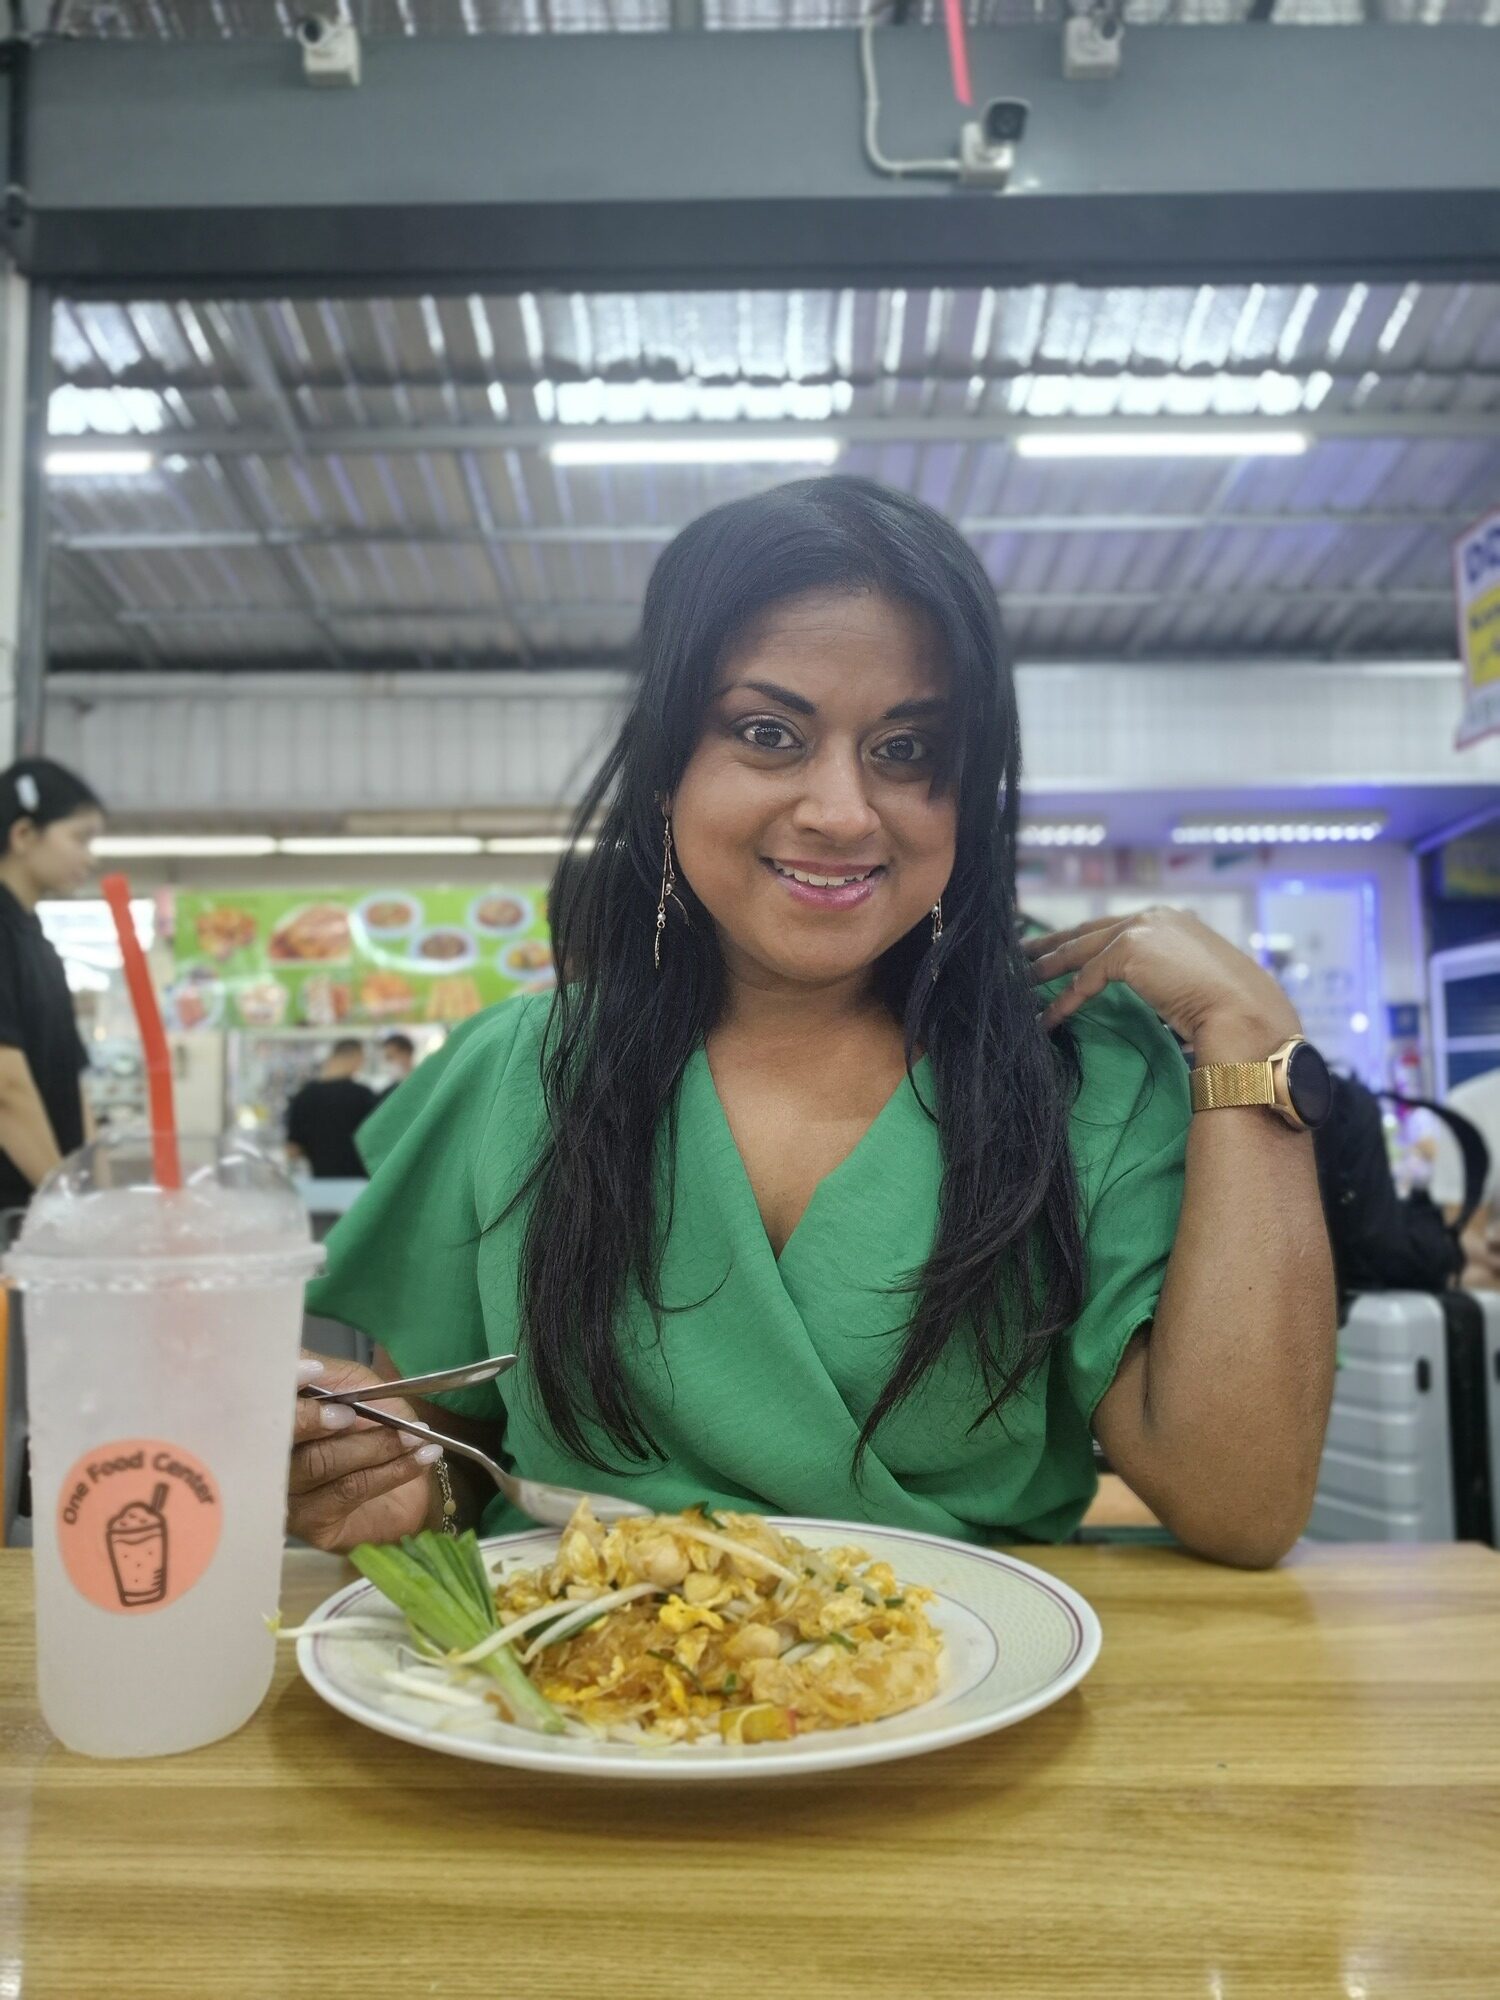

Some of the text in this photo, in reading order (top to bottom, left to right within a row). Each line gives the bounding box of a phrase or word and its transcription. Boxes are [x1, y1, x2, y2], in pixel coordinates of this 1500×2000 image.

[63, 1451, 214, 1525] One Food Center
